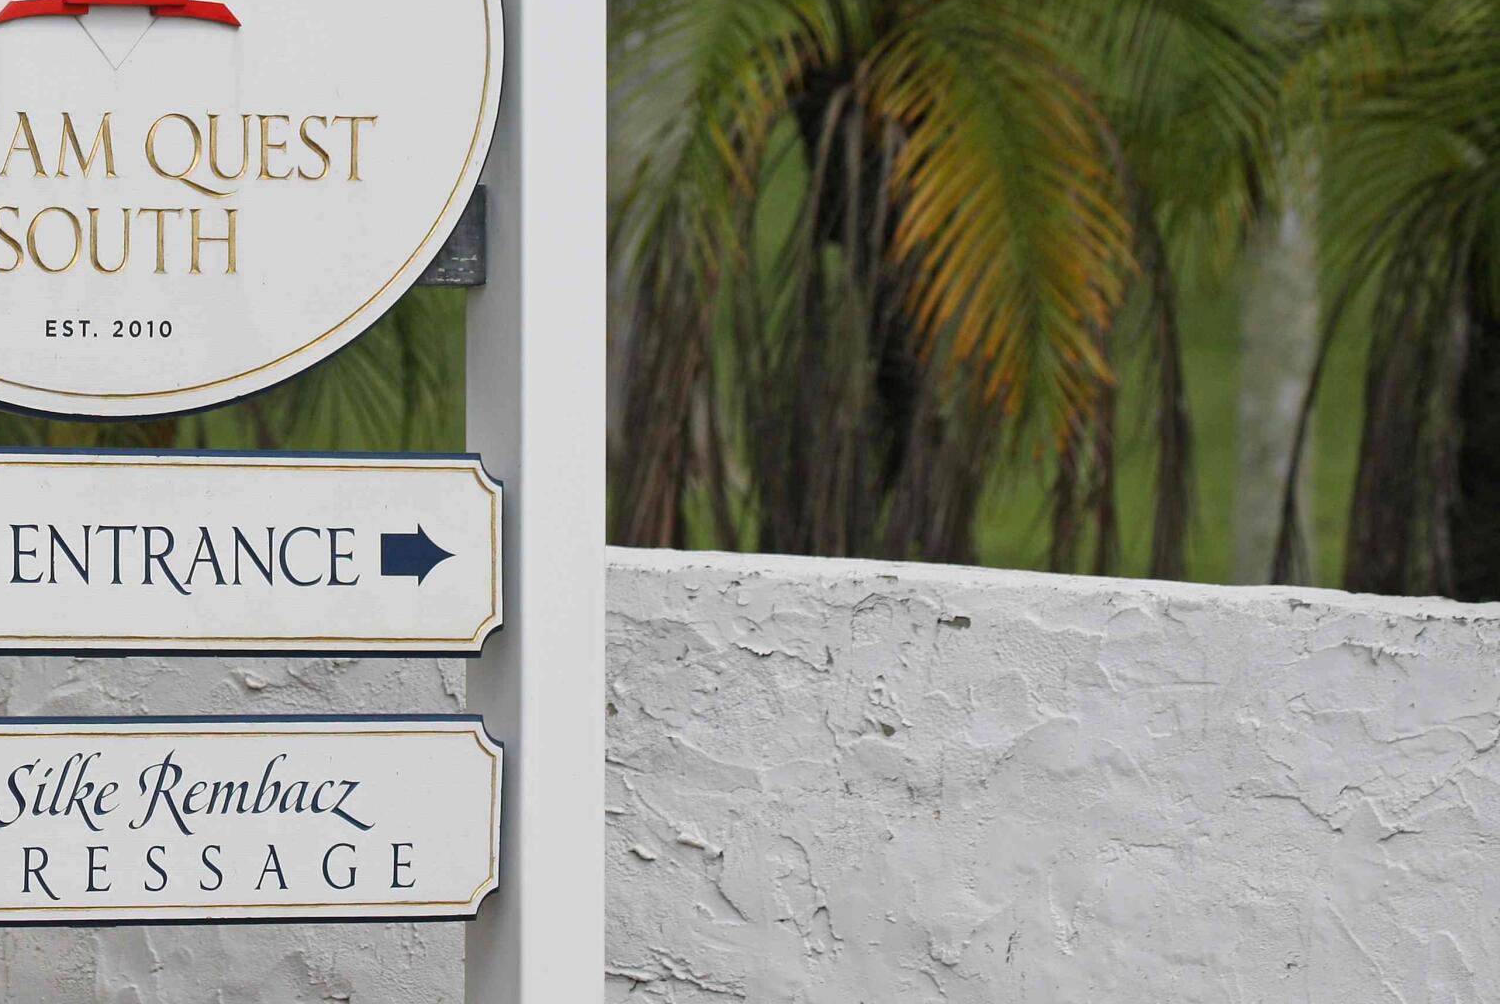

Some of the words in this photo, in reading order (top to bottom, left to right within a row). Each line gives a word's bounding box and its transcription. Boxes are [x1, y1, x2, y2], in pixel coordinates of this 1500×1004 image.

[144, 112, 378, 197] QUEST
[45, 320, 98, 338] EST.
[112, 320, 173, 339] 2010
[10, 524, 360, 595] ENTRANCE
[129, 749, 375, 835] Rembacz
